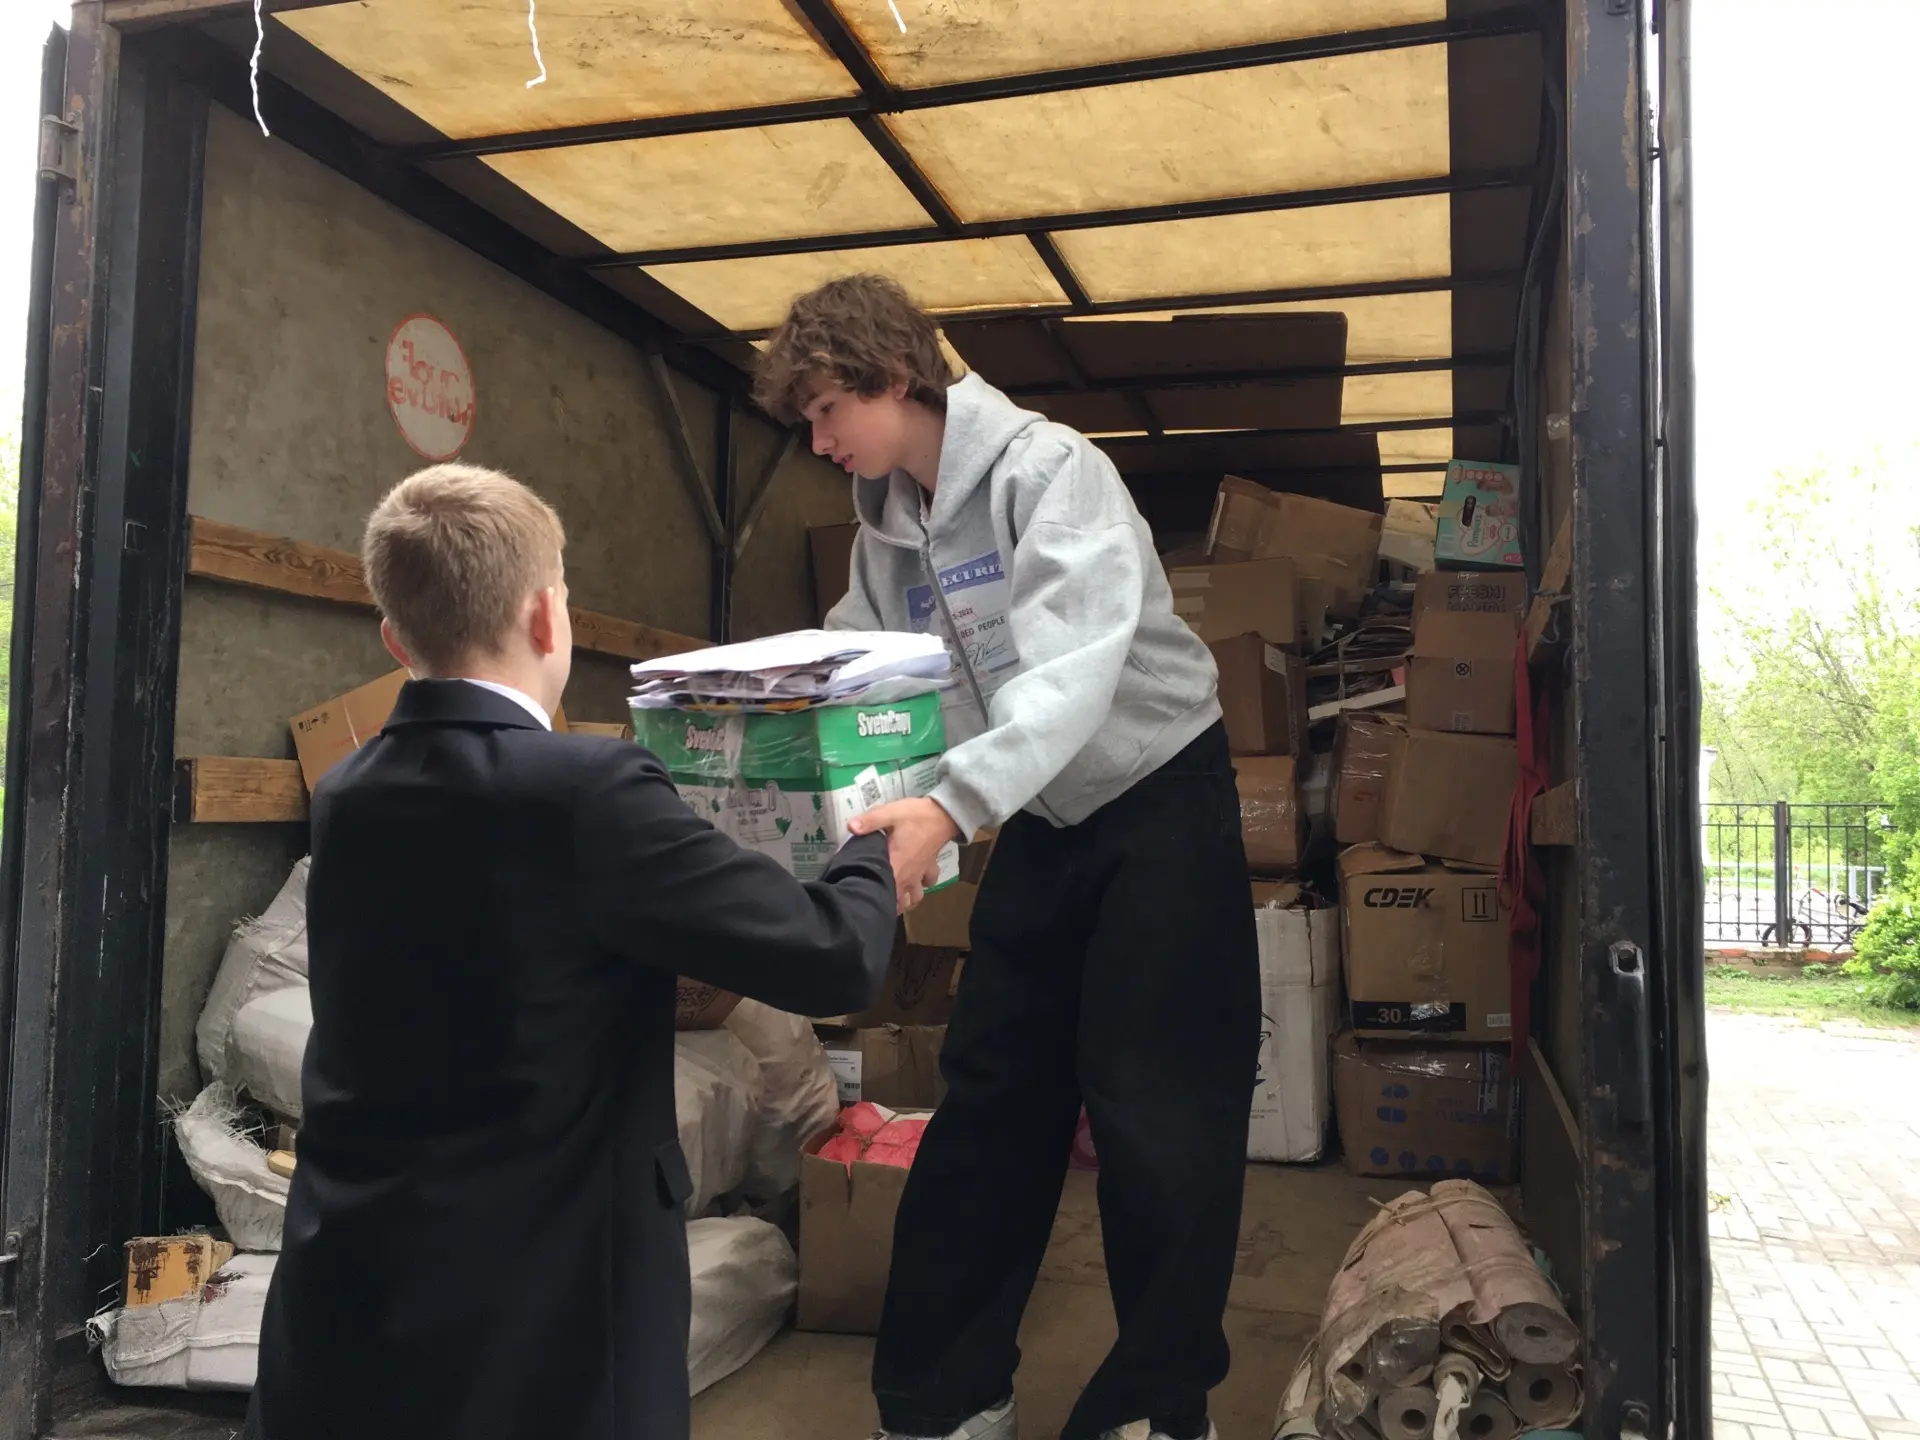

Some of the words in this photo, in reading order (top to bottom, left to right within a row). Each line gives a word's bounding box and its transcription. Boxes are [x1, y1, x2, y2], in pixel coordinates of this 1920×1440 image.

[977, 615, 1006, 632] PEOPLE
[1363, 887, 1435, 909] CDEK
[1377, 1007, 1402, 1024] 30
